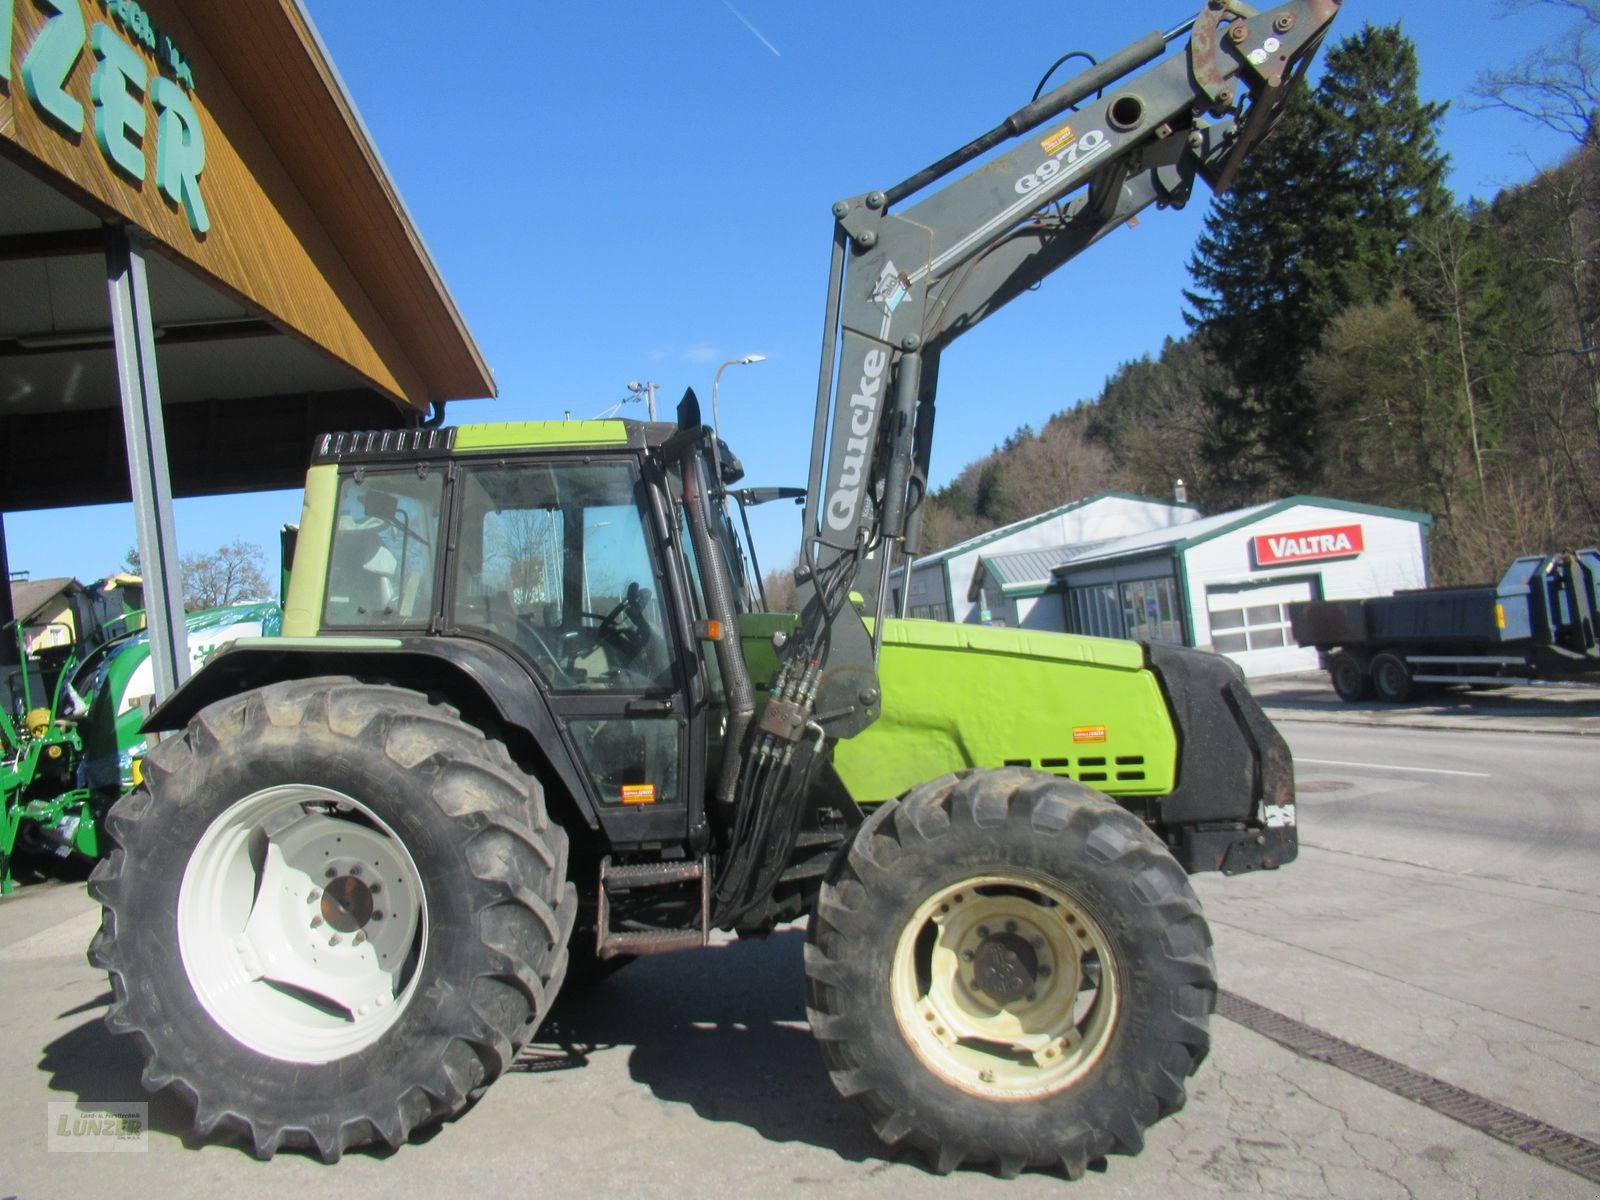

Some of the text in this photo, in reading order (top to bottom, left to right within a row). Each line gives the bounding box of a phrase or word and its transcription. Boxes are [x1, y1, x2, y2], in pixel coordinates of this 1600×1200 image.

[0, 0, 210, 233] ZER
[1015, 130, 1104, 193] Q970
[827, 349, 886, 531] Quicke
[1268, 533, 1352, 558] VALTRA
